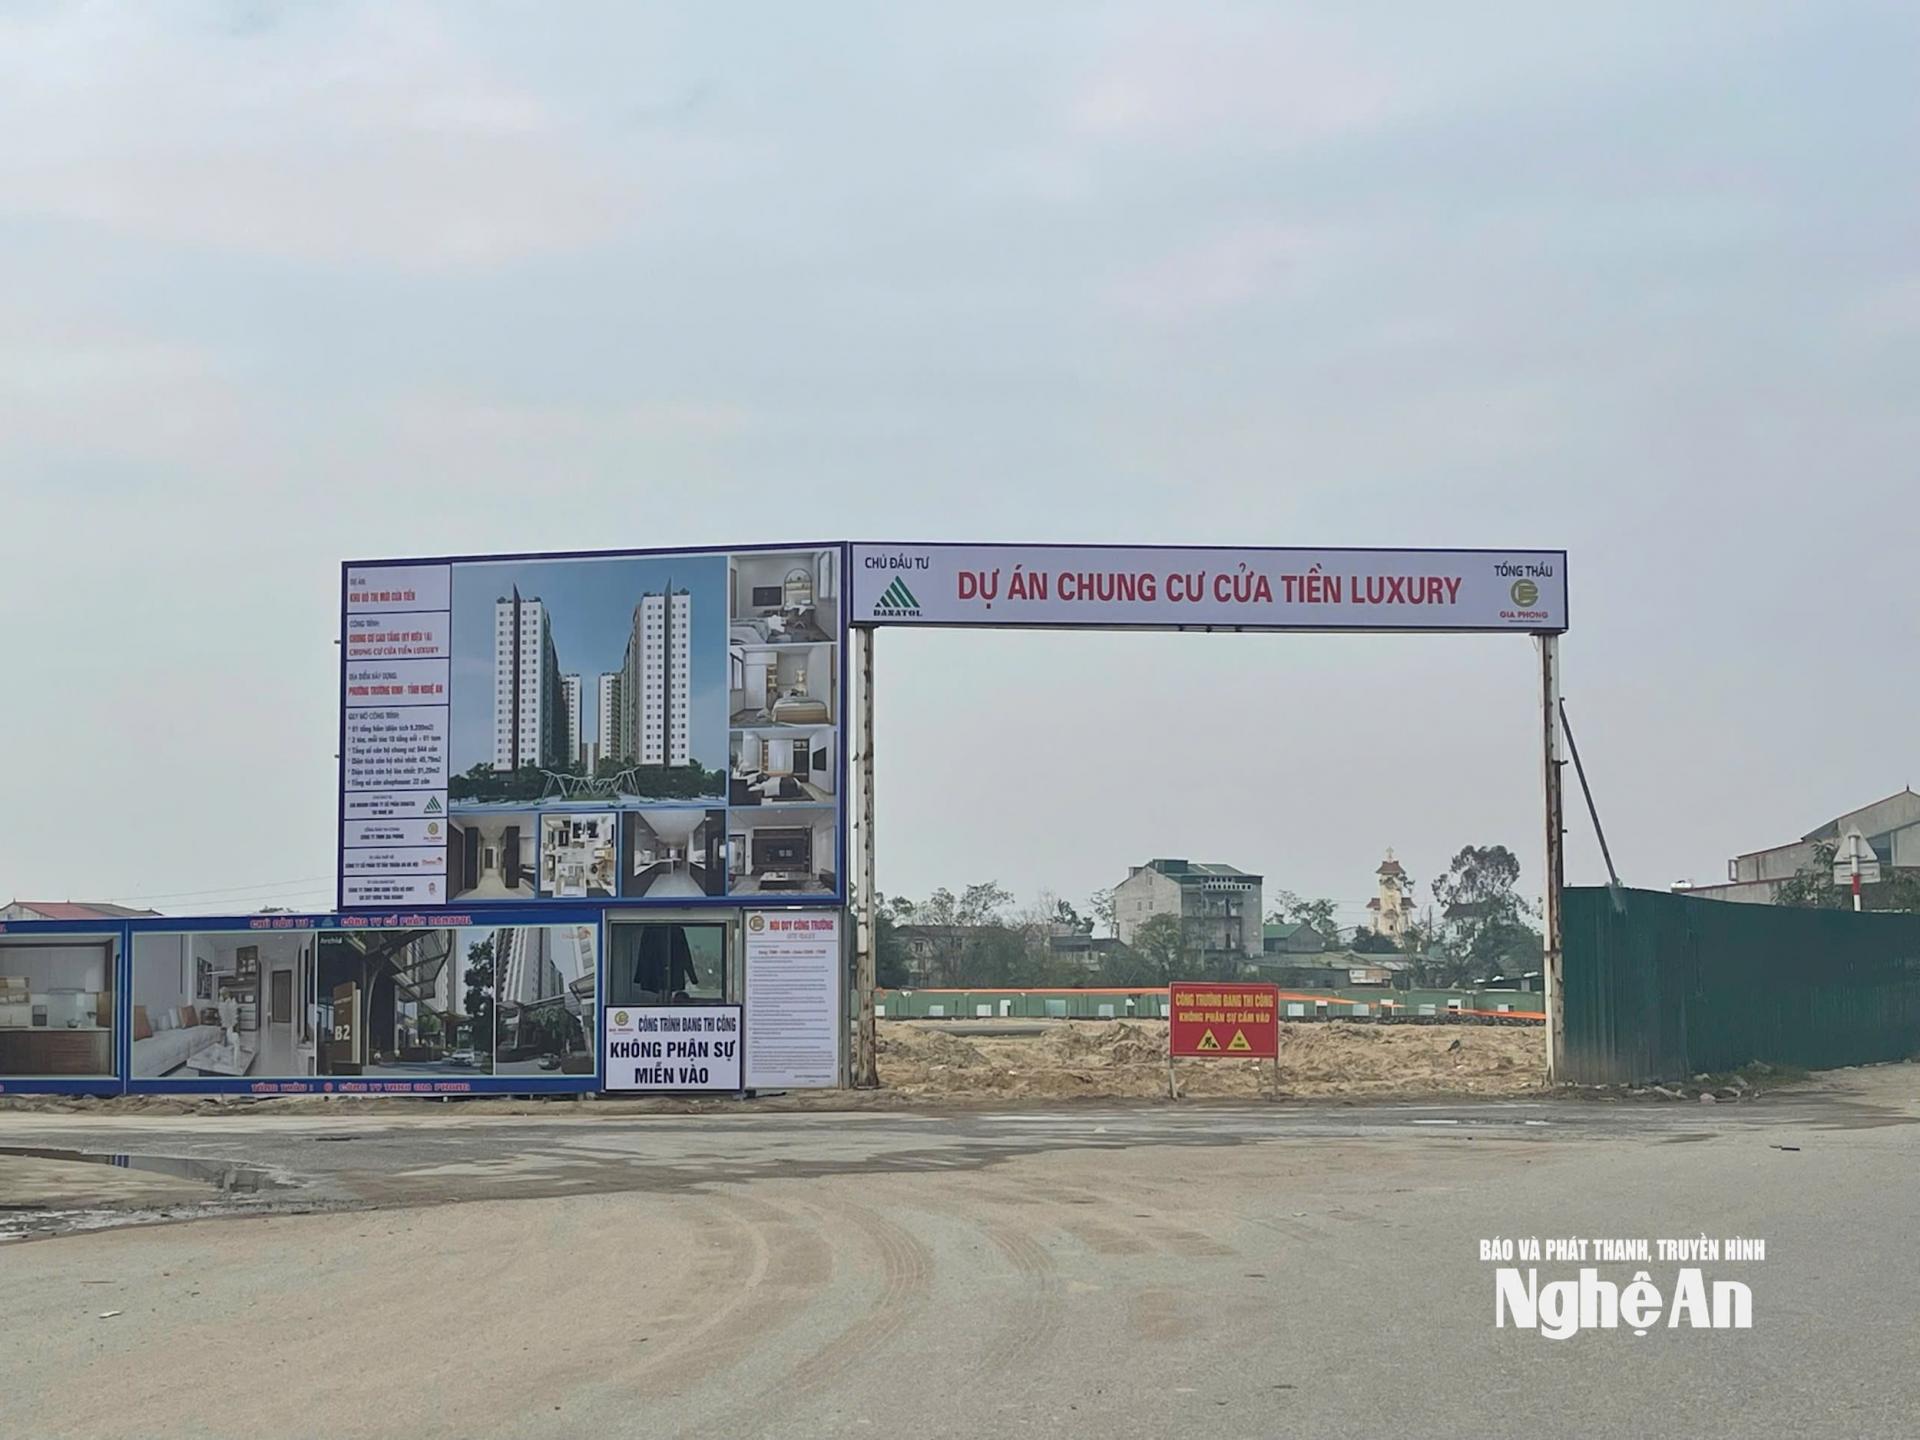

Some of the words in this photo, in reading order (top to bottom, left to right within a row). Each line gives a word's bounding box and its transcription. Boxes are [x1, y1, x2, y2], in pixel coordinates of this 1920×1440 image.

[915, 556, 929, 569] TƯ
[958, 568, 999, 609] DỰ
[1008, 564, 1047, 600] ÁN
[1057, 573, 1156, 601] CHUNG
[1166, 570, 1205, 602] CƯ
[1214, 563, 1273, 602] CỬA
[1281, 563, 1341, 604] TIỀN
[1352, 576, 1462, 605] LUXURY
[335, 1024, 350, 1040] B2
[638, 1014, 658, 1032] CÔNG
[660, 1014, 680, 1032] TRÌNH
[682, 1017, 702, 1032] ĐANG
[704, 1017, 715, 1032] THI
[716, 1014, 736, 1032] CÔNG
[610, 1038, 662, 1058] KHÔNG
[667, 1038, 708, 1062] PHẬN
[714, 1040, 736, 1061] SỰ
[635, 1061, 674, 1084] MIỄN
[679, 1064, 709, 1084] VÀO
